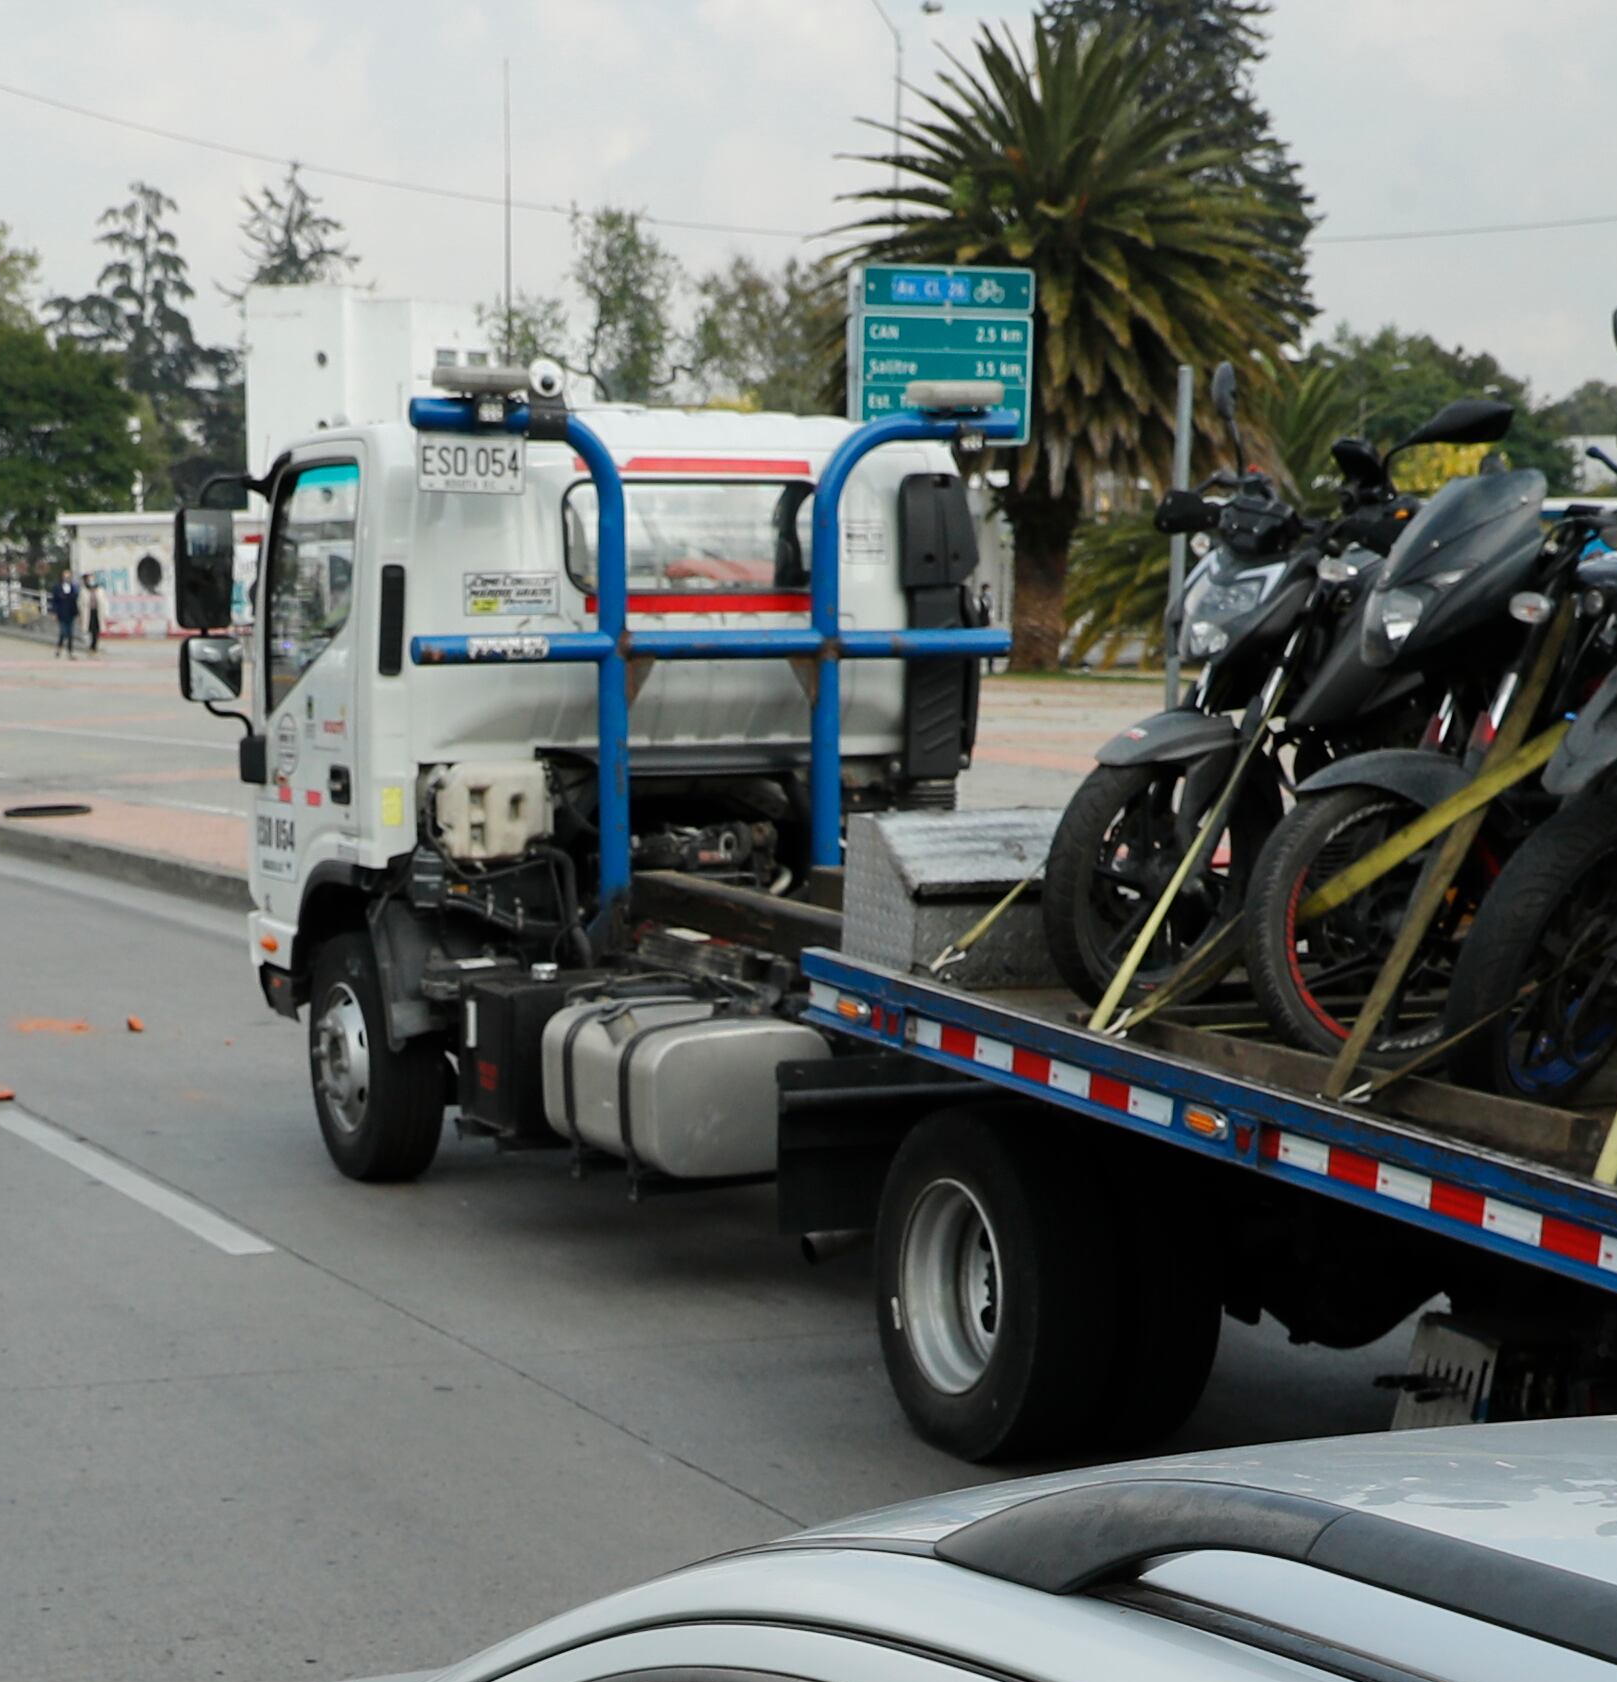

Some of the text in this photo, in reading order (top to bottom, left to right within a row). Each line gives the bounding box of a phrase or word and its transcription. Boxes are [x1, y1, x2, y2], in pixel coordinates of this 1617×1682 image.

[869, 322, 1024, 343] CAN 2.5 km
[869, 358, 1023, 377] Salitre 3.5 km
[422, 445, 520, 478] ESO 054
